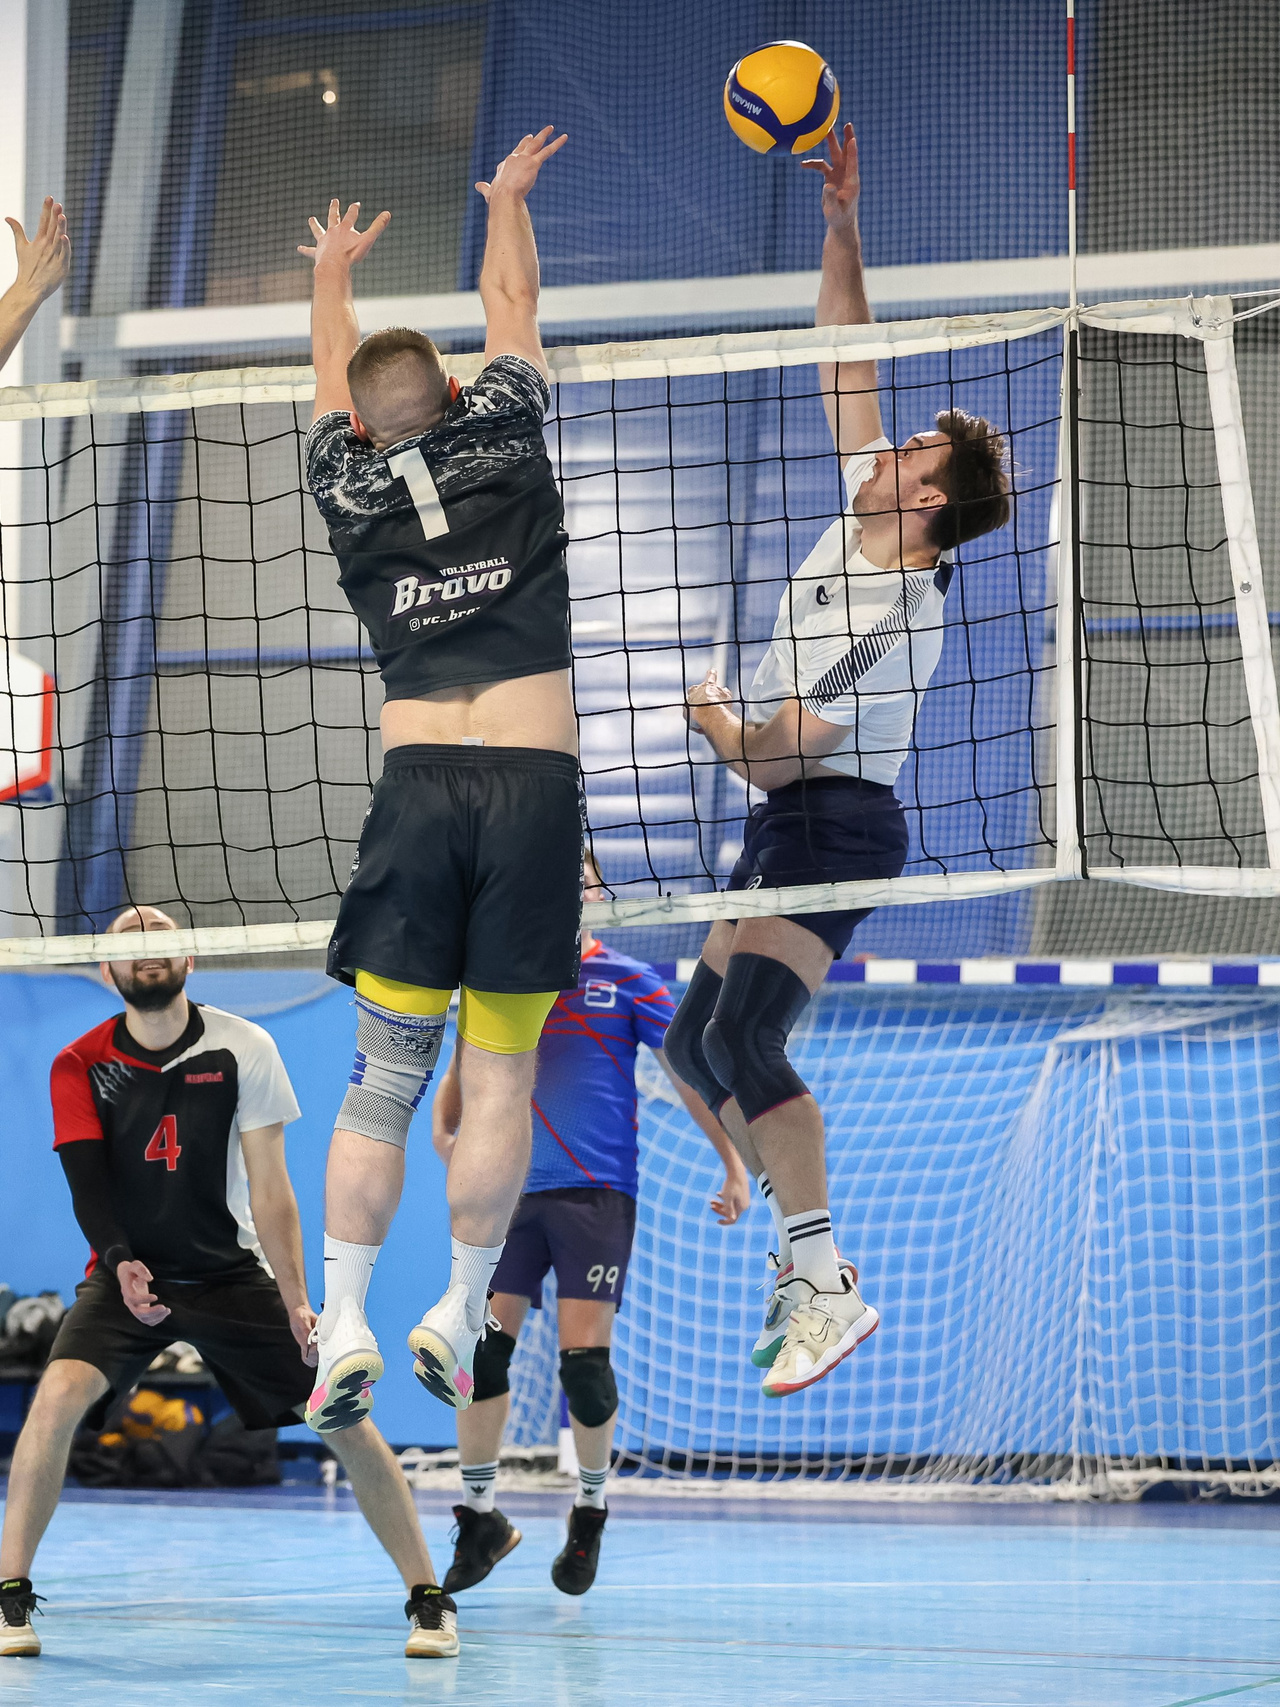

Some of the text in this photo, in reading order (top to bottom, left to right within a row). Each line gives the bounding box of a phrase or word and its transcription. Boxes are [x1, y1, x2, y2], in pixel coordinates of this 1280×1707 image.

[386, 446, 450, 541] 1
[439, 556, 509, 577] VOLLEYBALL
[390, 568, 512, 616] Bravo
[145, 1114, 182, 1171] 4
[586, 1264, 620, 1294] 99
